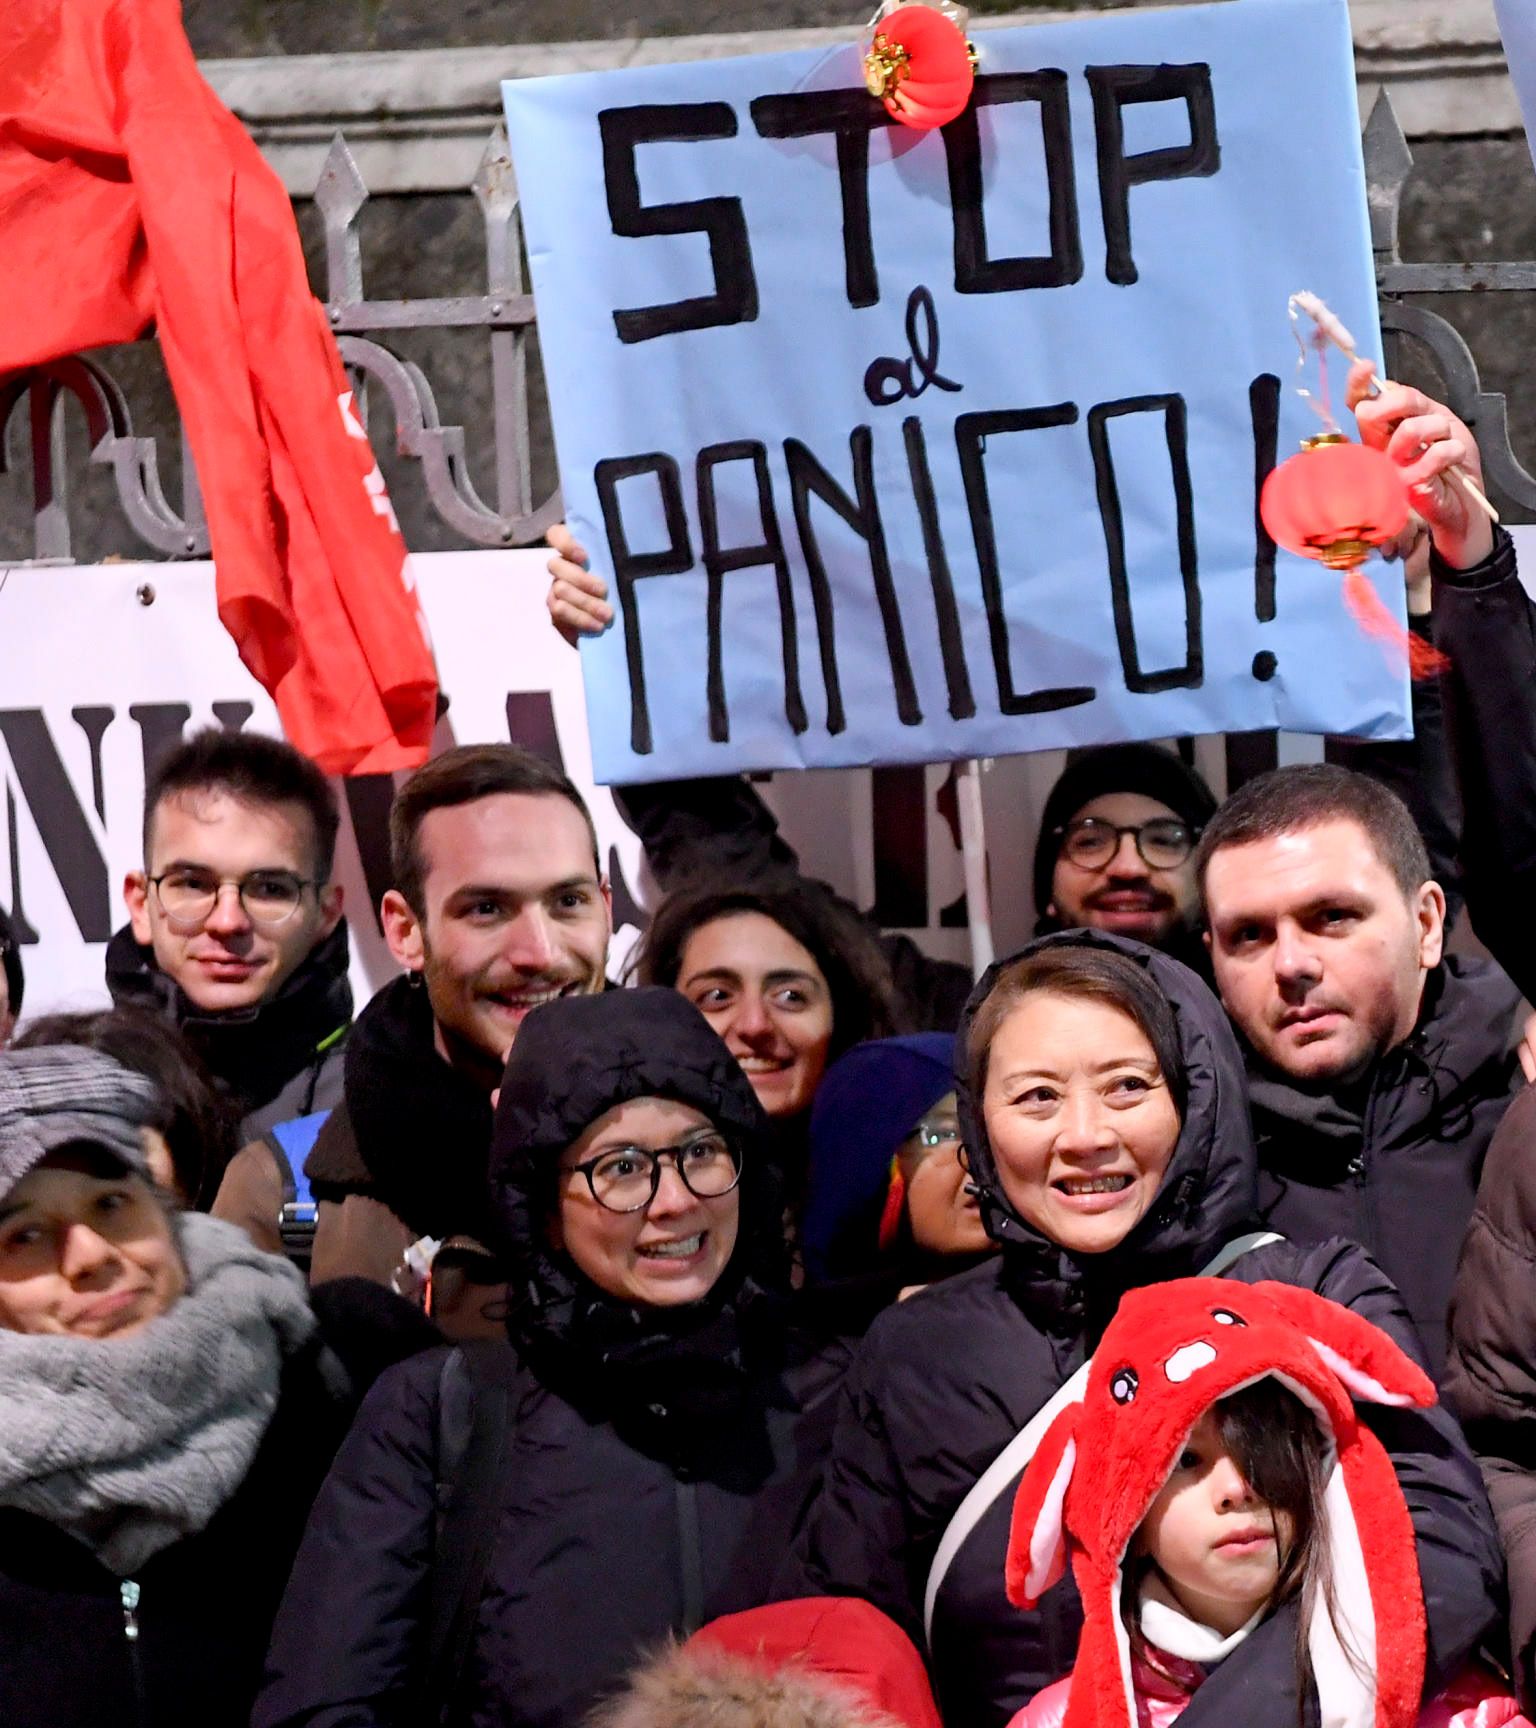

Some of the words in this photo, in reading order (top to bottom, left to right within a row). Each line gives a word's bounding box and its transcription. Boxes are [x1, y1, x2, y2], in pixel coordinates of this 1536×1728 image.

[598, 62, 1222, 345] STOP
[863, 284, 965, 406] al
[593, 374, 1282, 755] PANICO!
